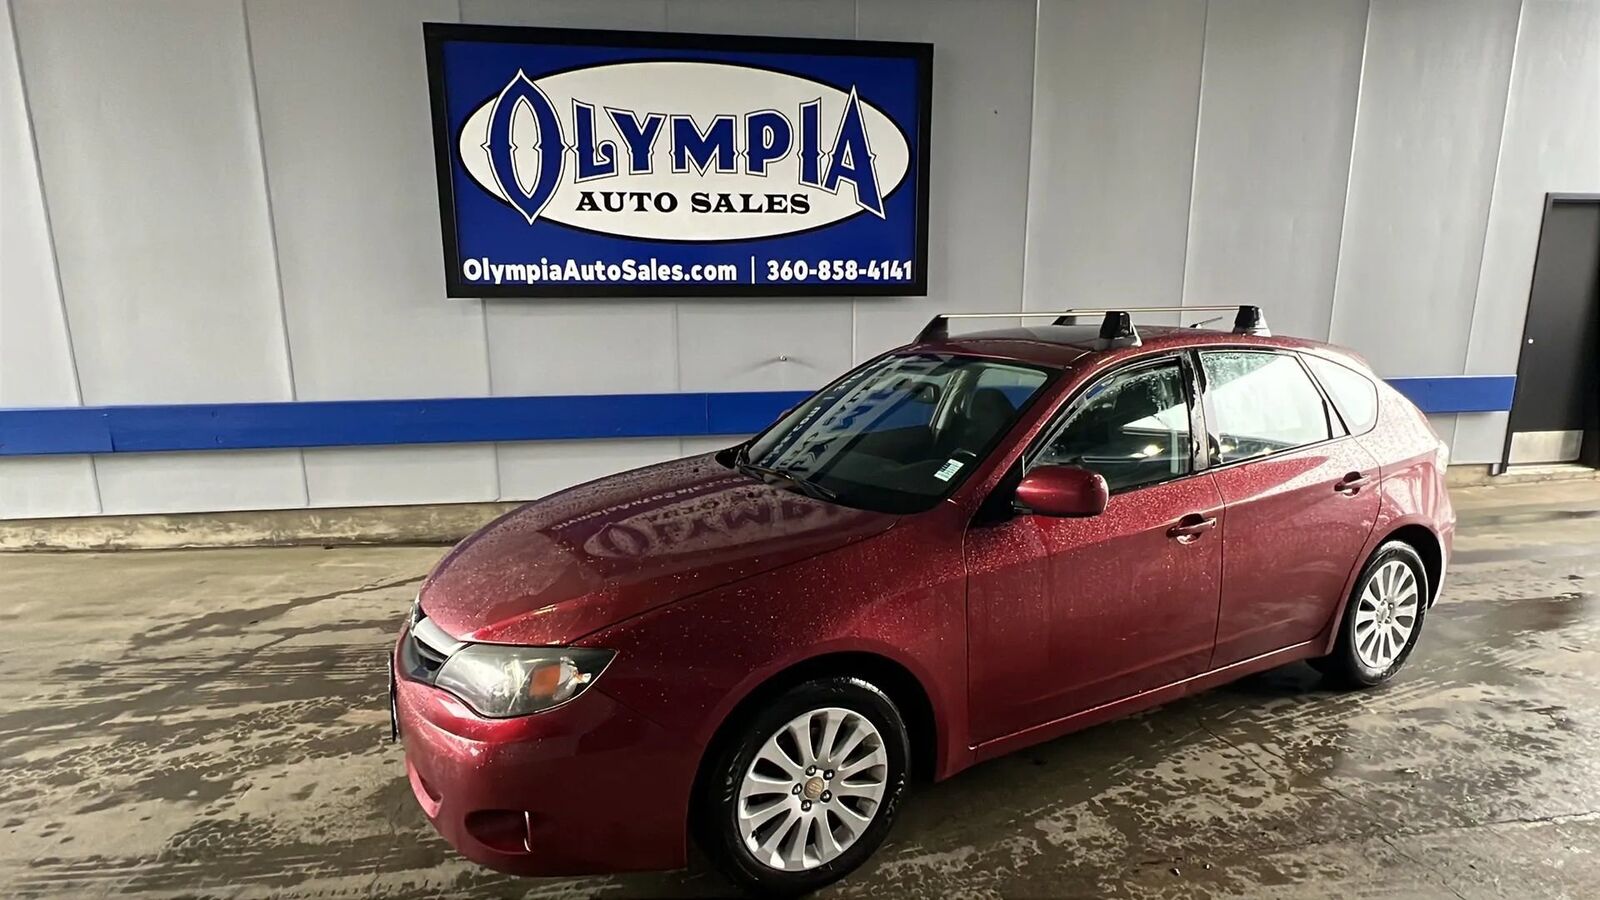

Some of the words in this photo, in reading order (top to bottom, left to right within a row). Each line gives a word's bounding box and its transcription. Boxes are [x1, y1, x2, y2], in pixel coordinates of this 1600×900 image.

[481, 68, 885, 225] OLYMPIA
[575, 191, 678, 213] AUTO
[691, 193, 810, 214] SALES
[463, 257, 737, 285] OlympiaAutoSales.com
[766, 260, 912, 282] 360-858-4141
